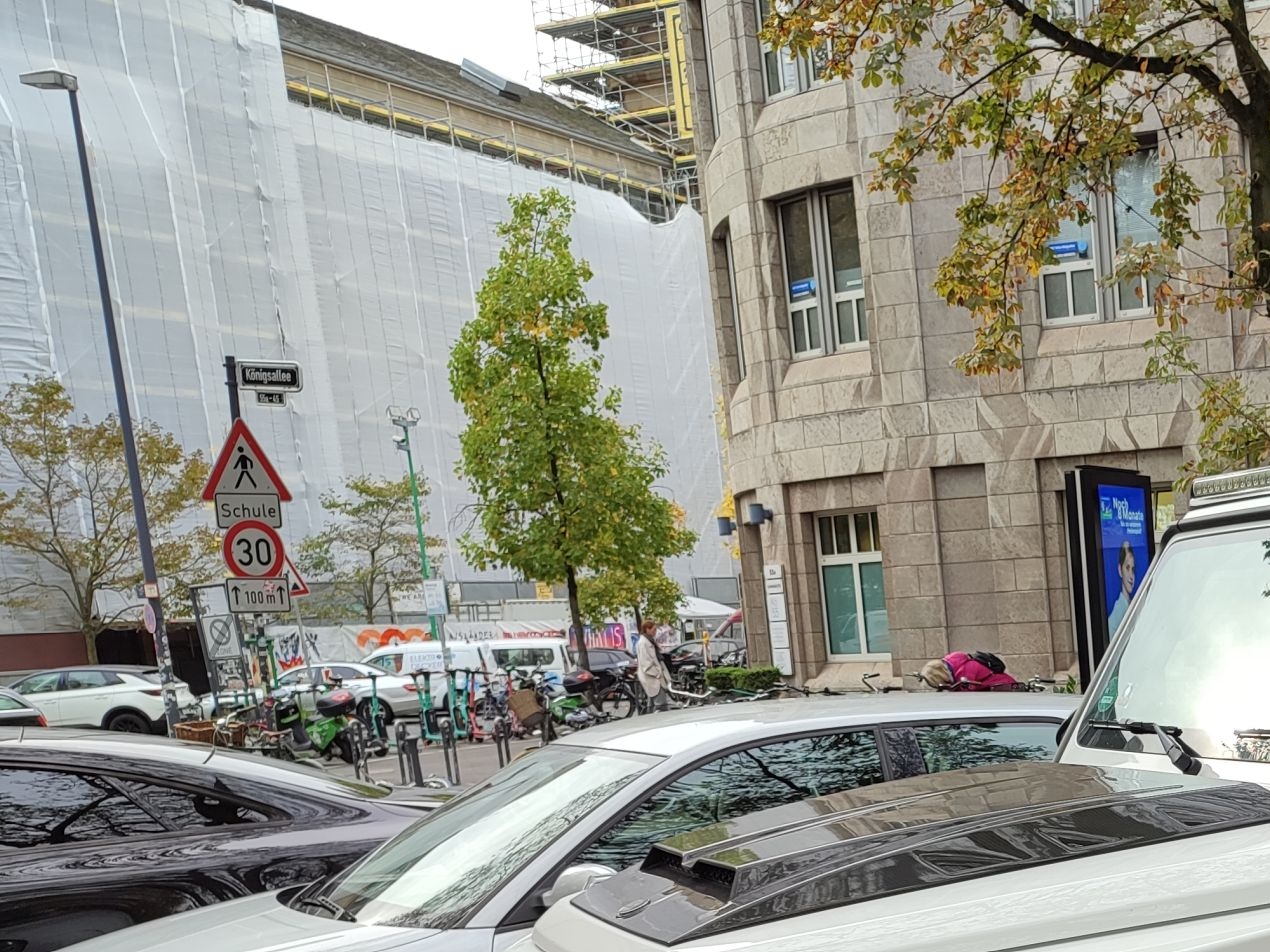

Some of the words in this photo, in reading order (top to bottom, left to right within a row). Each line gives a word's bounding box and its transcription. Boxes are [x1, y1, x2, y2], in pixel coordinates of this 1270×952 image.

[245, 368, 292, 384] Königsallee
[221, 502, 277, 519] Schule
[1112, 497, 1129, 509] Noch
[235, 538, 272, 567] 30
[245, 591, 264, 605] 100
[265, 592, 276, 604] m
[611, 626, 622, 647] IS
